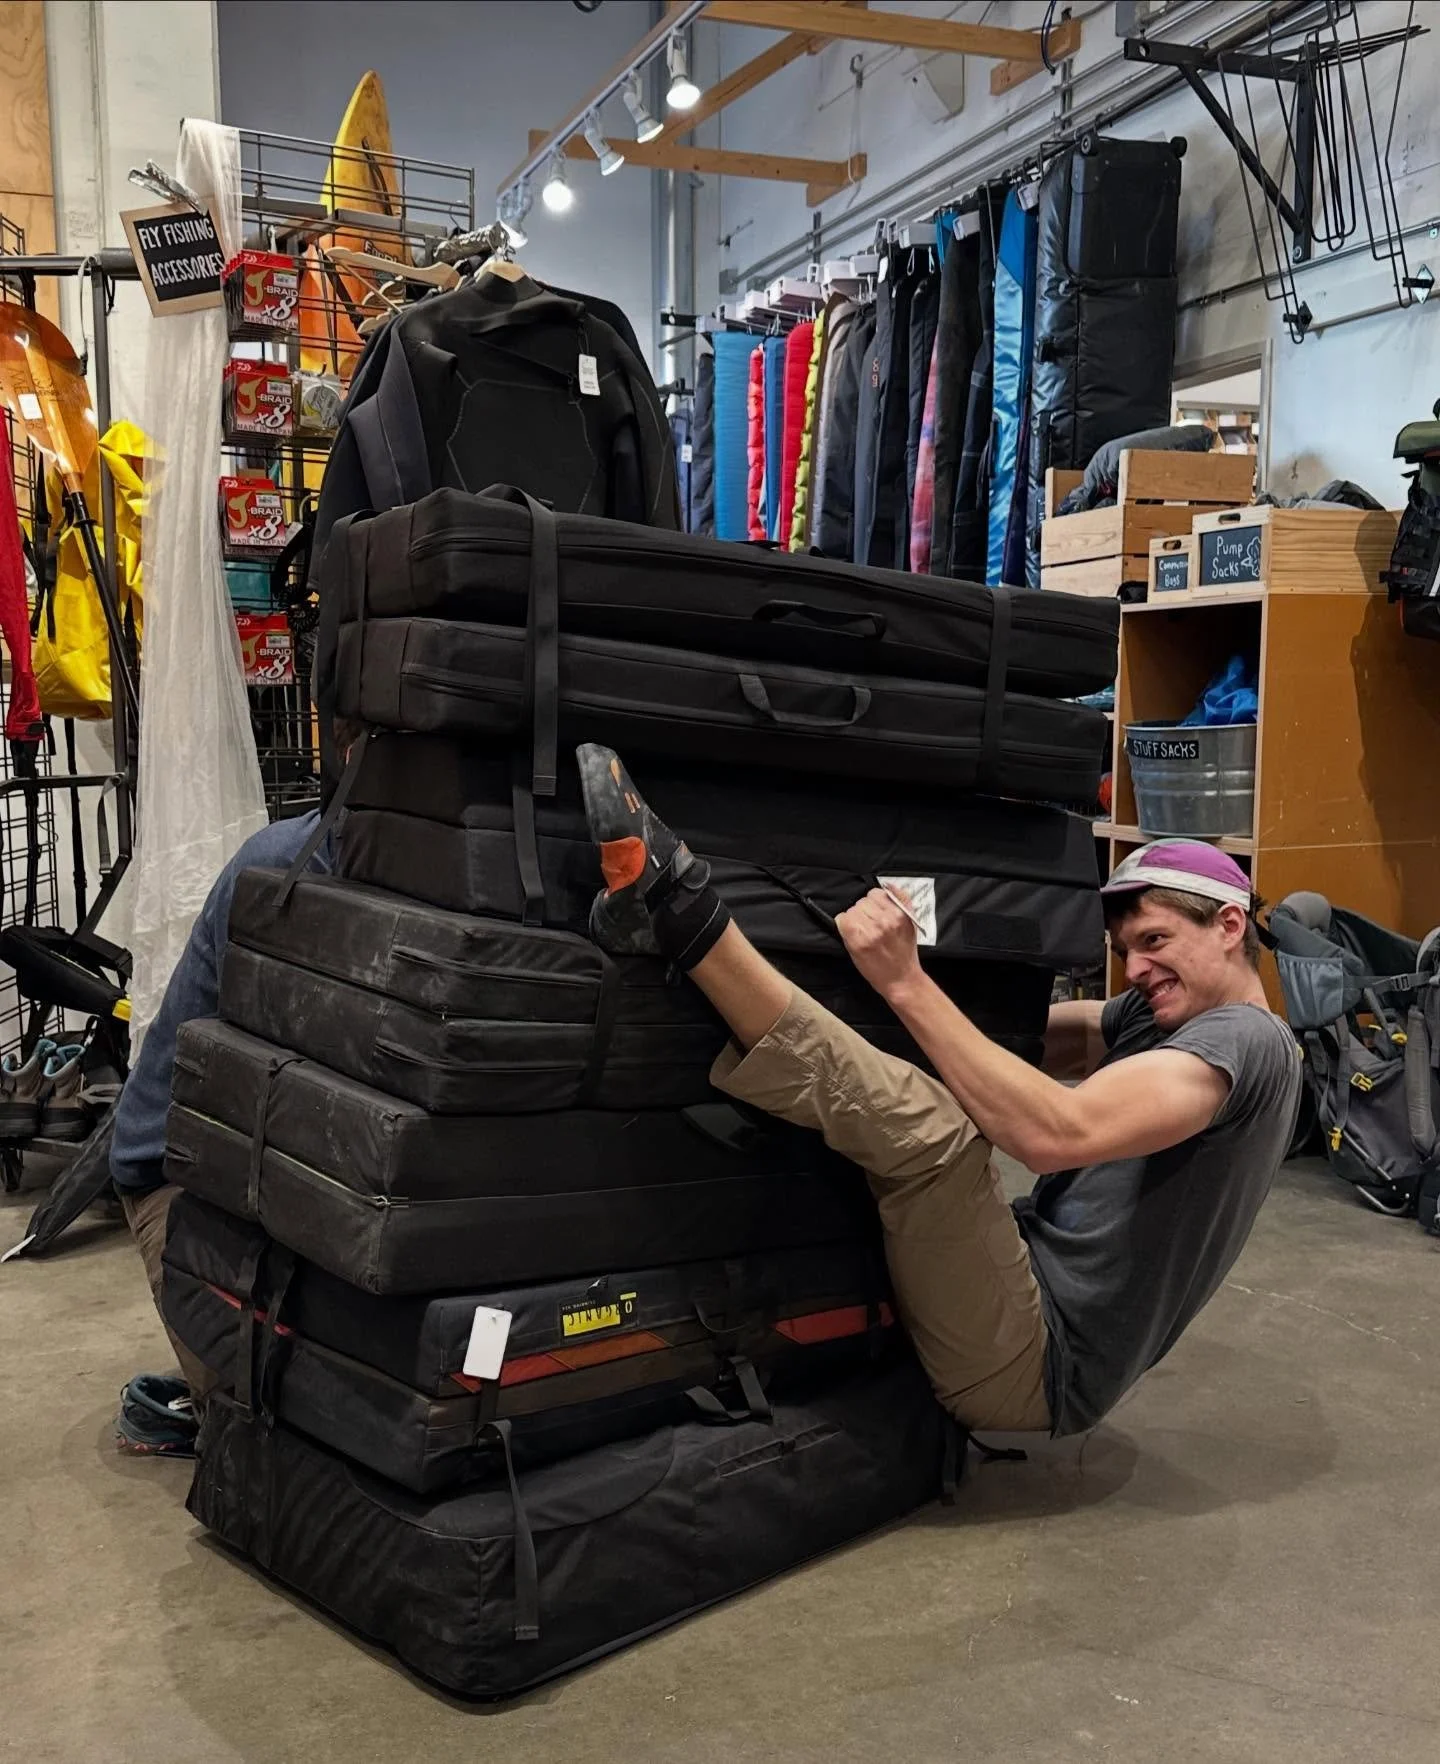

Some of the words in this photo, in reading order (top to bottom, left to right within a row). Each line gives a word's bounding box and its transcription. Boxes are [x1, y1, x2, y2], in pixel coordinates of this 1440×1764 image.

[138, 226, 161, 250] FLY
[162, 218, 214, 246] FISHING
[151, 252, 224, 287] ACCESSORIES
[1217, 536, 1243, 558] Pump
[1212, 557, 1239, 579] Sacks
[1133, 740, 1159, 757] STUFF
[1160, 742, 1196, 758] SACKS
